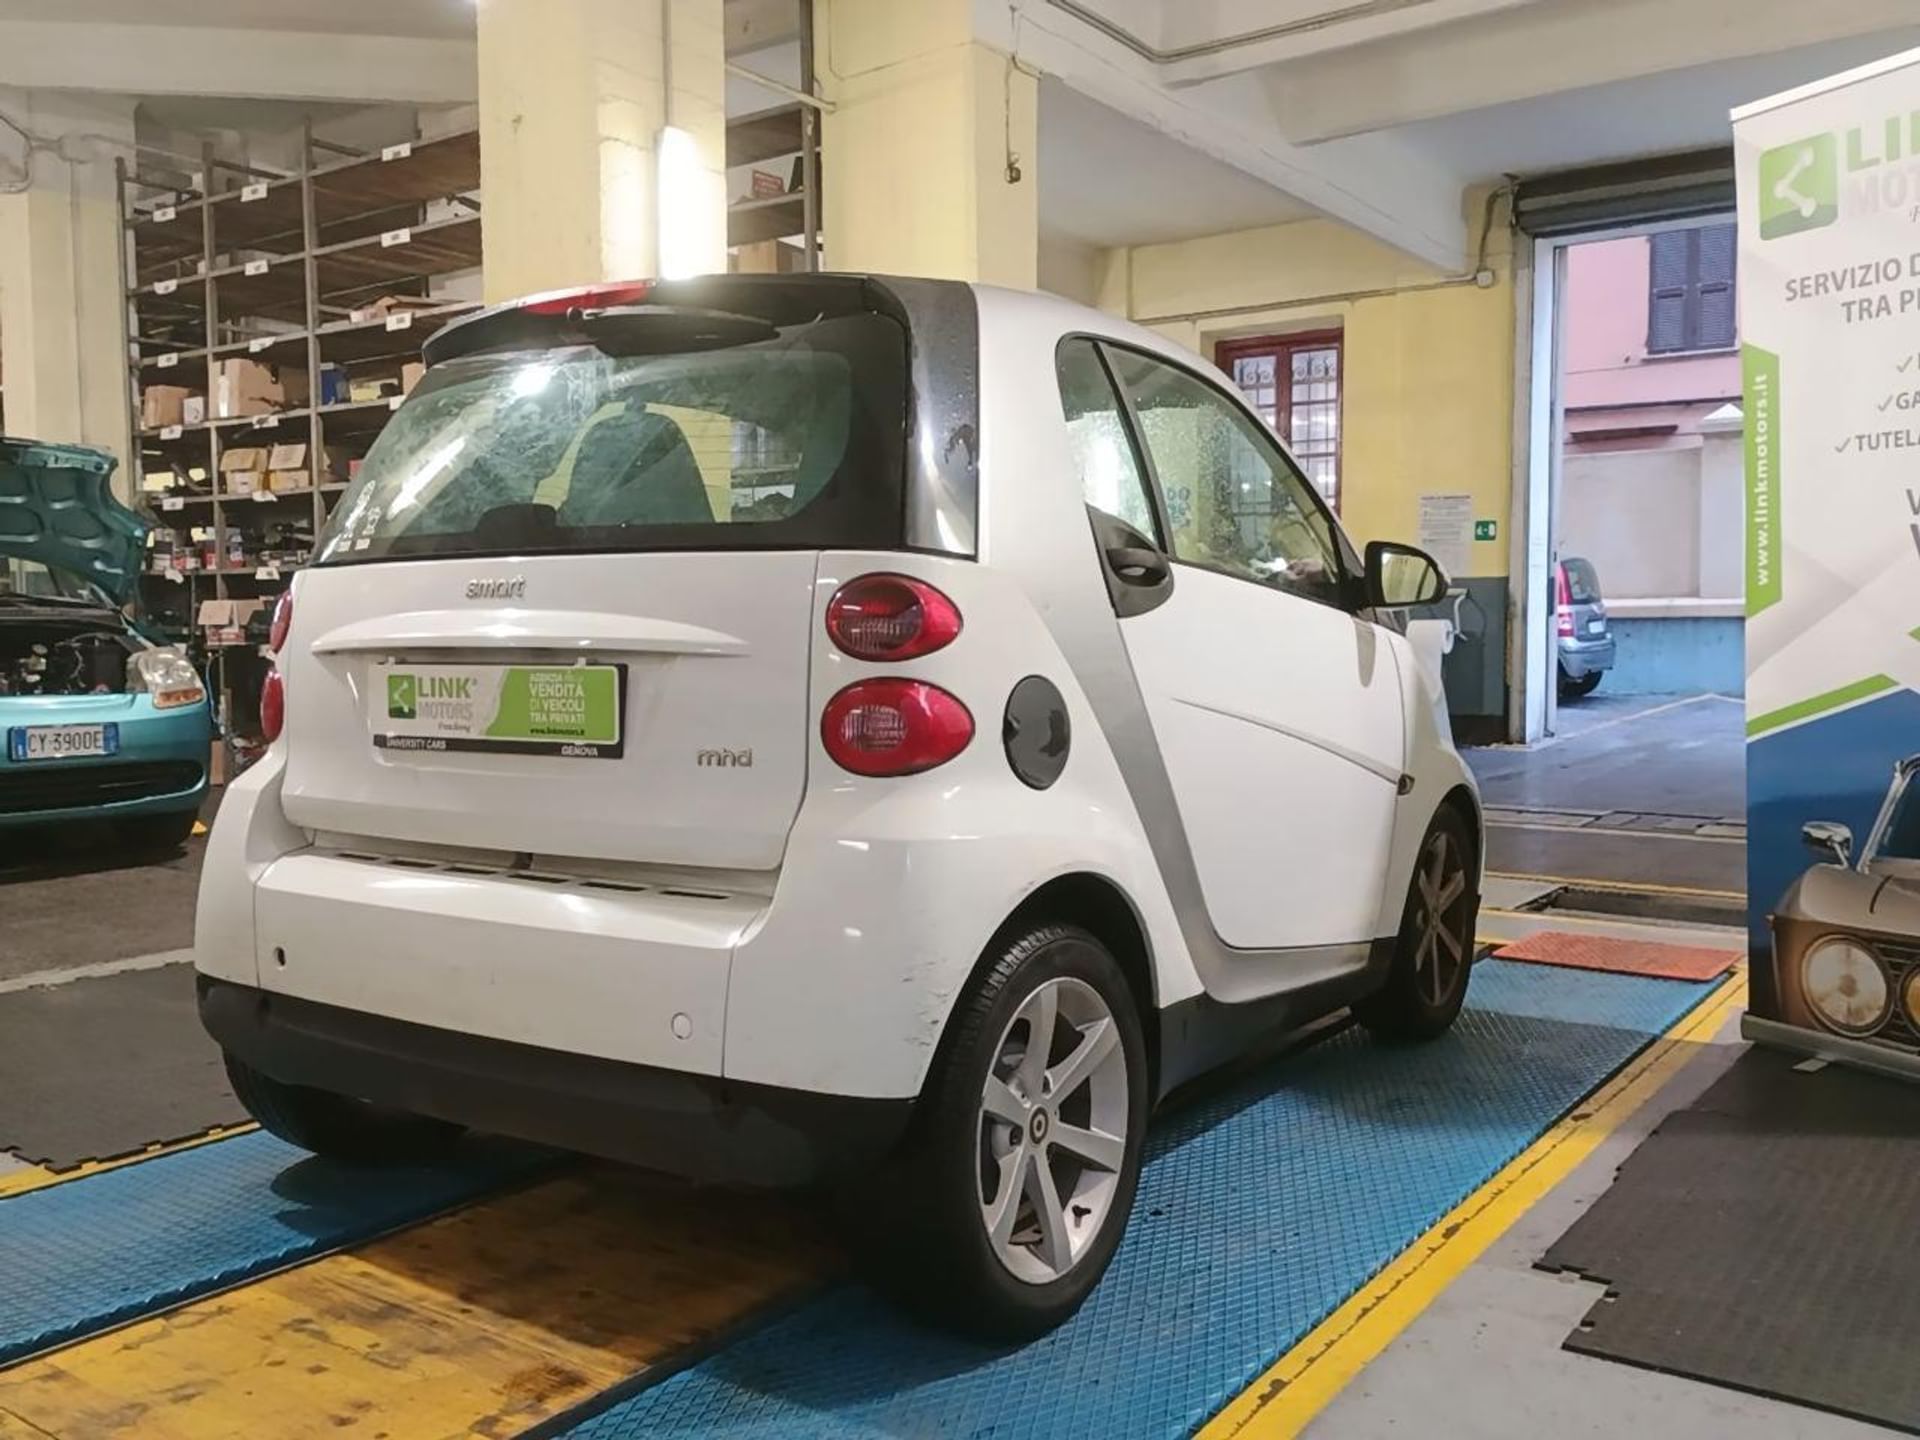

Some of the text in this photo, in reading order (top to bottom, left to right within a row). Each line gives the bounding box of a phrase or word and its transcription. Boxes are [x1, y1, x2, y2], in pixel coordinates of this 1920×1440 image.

[1785, 258, 1901, 302] SERVIZIO
[1841, 287, 1920, 323] TRA P
[1855, 429, 1920, 451] TUTEL
[1752, 373, 1769, 587] www.linkmotors.it
[466, 576, 525, 599] smart
[418, 677, 471, 699] LINK
[529, 683, 585, 697] VENDITA
[697, 747, 753, 767] mhd
